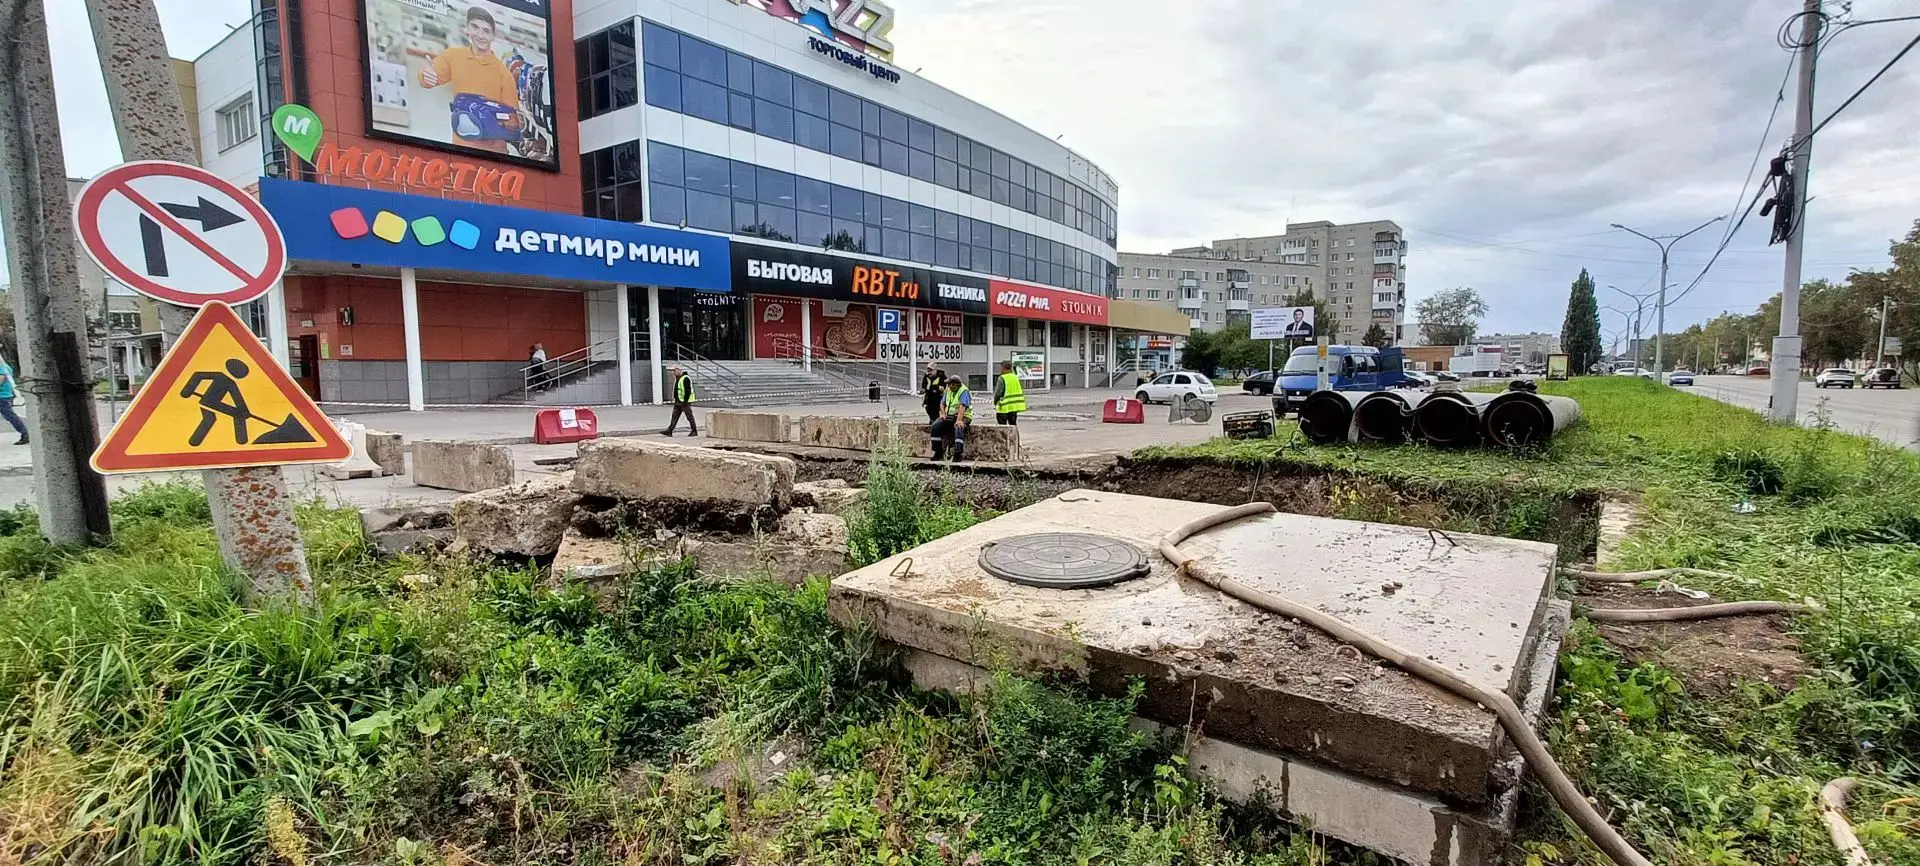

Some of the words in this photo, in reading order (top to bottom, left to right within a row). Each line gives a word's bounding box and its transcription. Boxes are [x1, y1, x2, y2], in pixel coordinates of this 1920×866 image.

[807, 36, 868, 71] ТОРГОВЫЙ
[869, 62, 901, 84] ЦЕНТР
[495, 227, 625, 266] детмир
[628, 242, 700, 268] мини
[747, 258, 834, 286] БЫТОВАЯ
[851, 265, 920, 300] RBT.ru
[937, 283, 986, 302] ТЕХНИКА
[997, 291, 1027, 308] PIZZA
[1061, 300, 1103, 316] STOLNIK
[883, 312, 896, 329] P
[880, 343, 887, 359] 8
[890, 343, 909, 359] 904
[916, 344, 961, 359] 4-36-888
